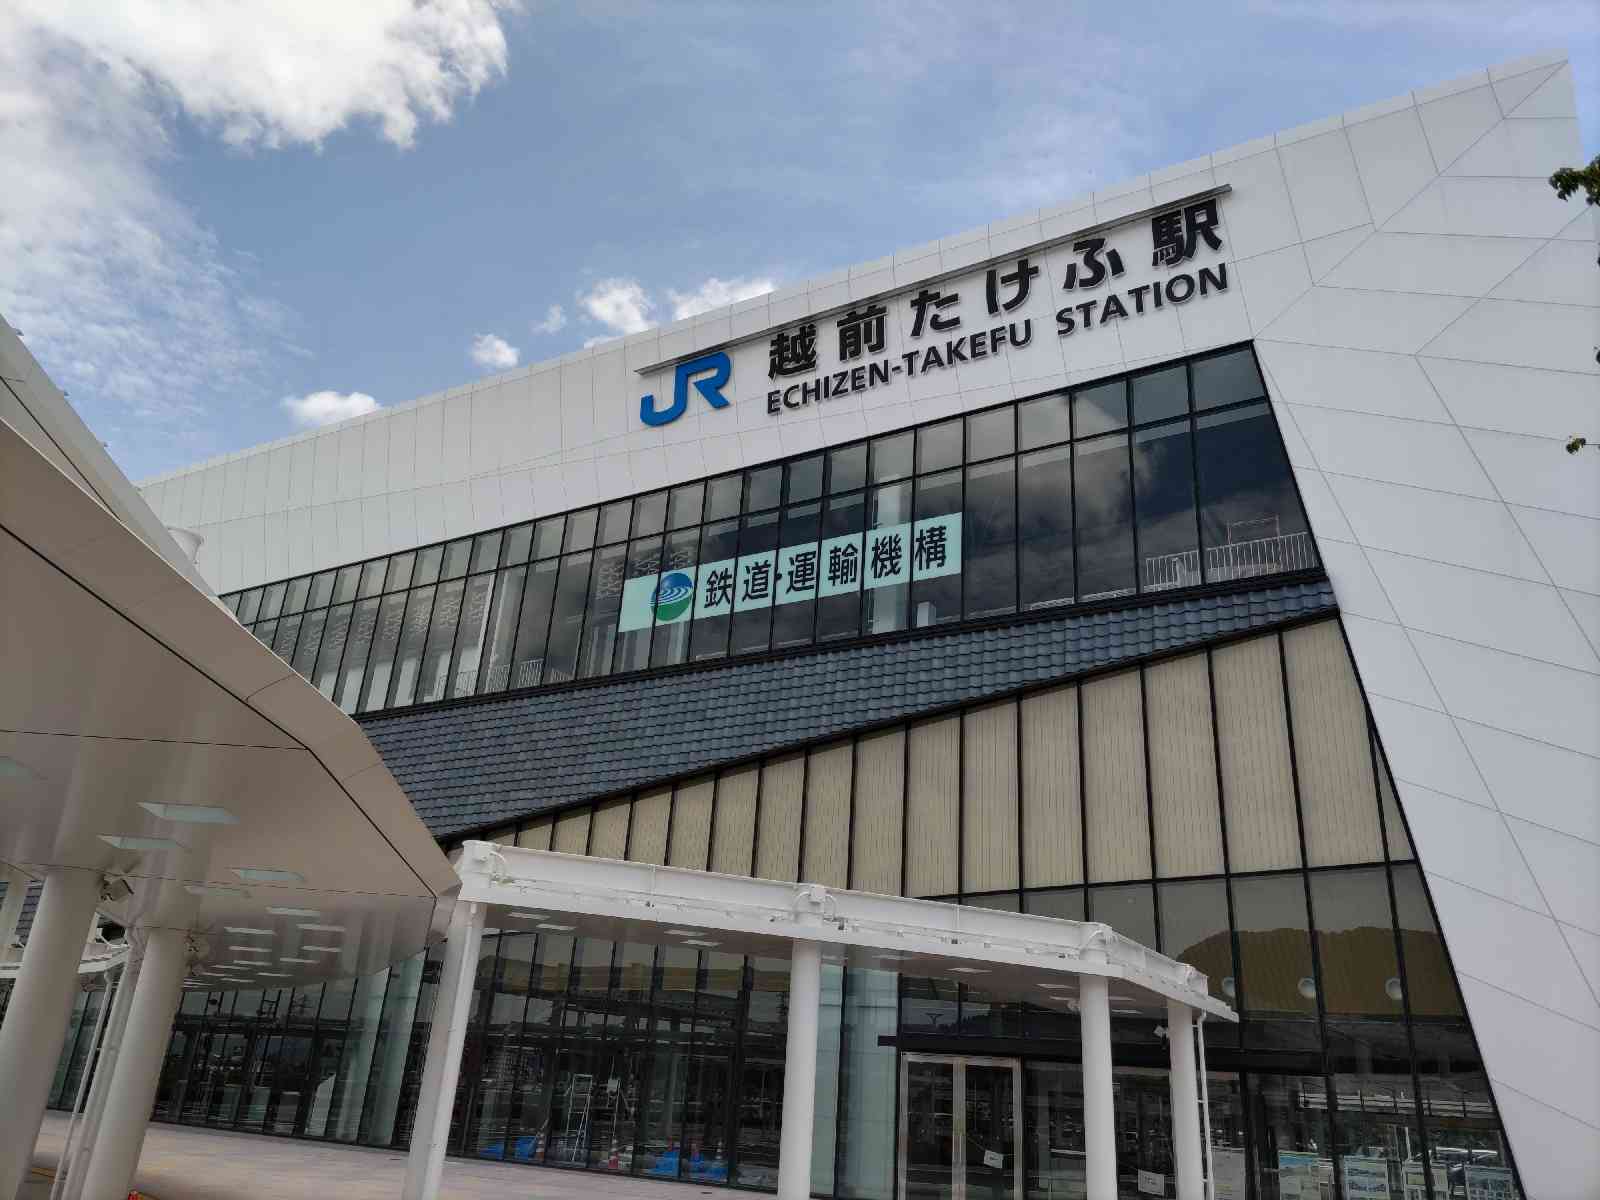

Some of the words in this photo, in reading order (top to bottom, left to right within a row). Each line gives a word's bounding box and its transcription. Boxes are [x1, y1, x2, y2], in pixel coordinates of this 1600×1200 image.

[768, 199, 1223, 379] 越前たけふ駅
[768, 319, 1032, 414] ECHIZEN-TAKEFU
[1056, 263, 1229, 336] STATION
[640, 351, 731, 426] JR
